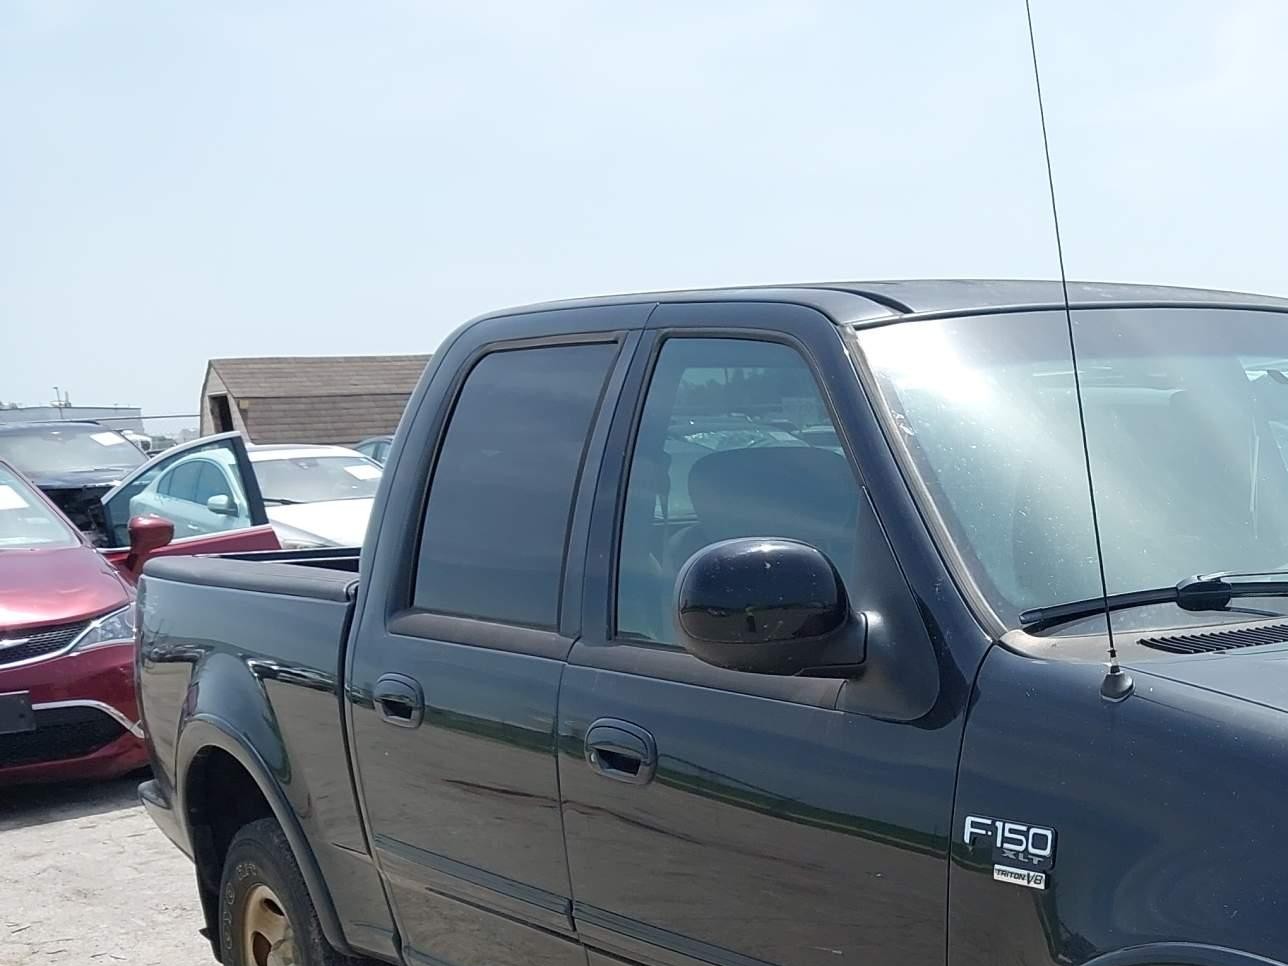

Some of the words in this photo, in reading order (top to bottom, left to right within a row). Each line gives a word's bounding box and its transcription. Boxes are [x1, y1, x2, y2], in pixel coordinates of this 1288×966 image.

[1000, 849, 1044, 865] XLT
[995, 868, 1026, 881] TRITON
[1025, 872, 1043, 885] V8
